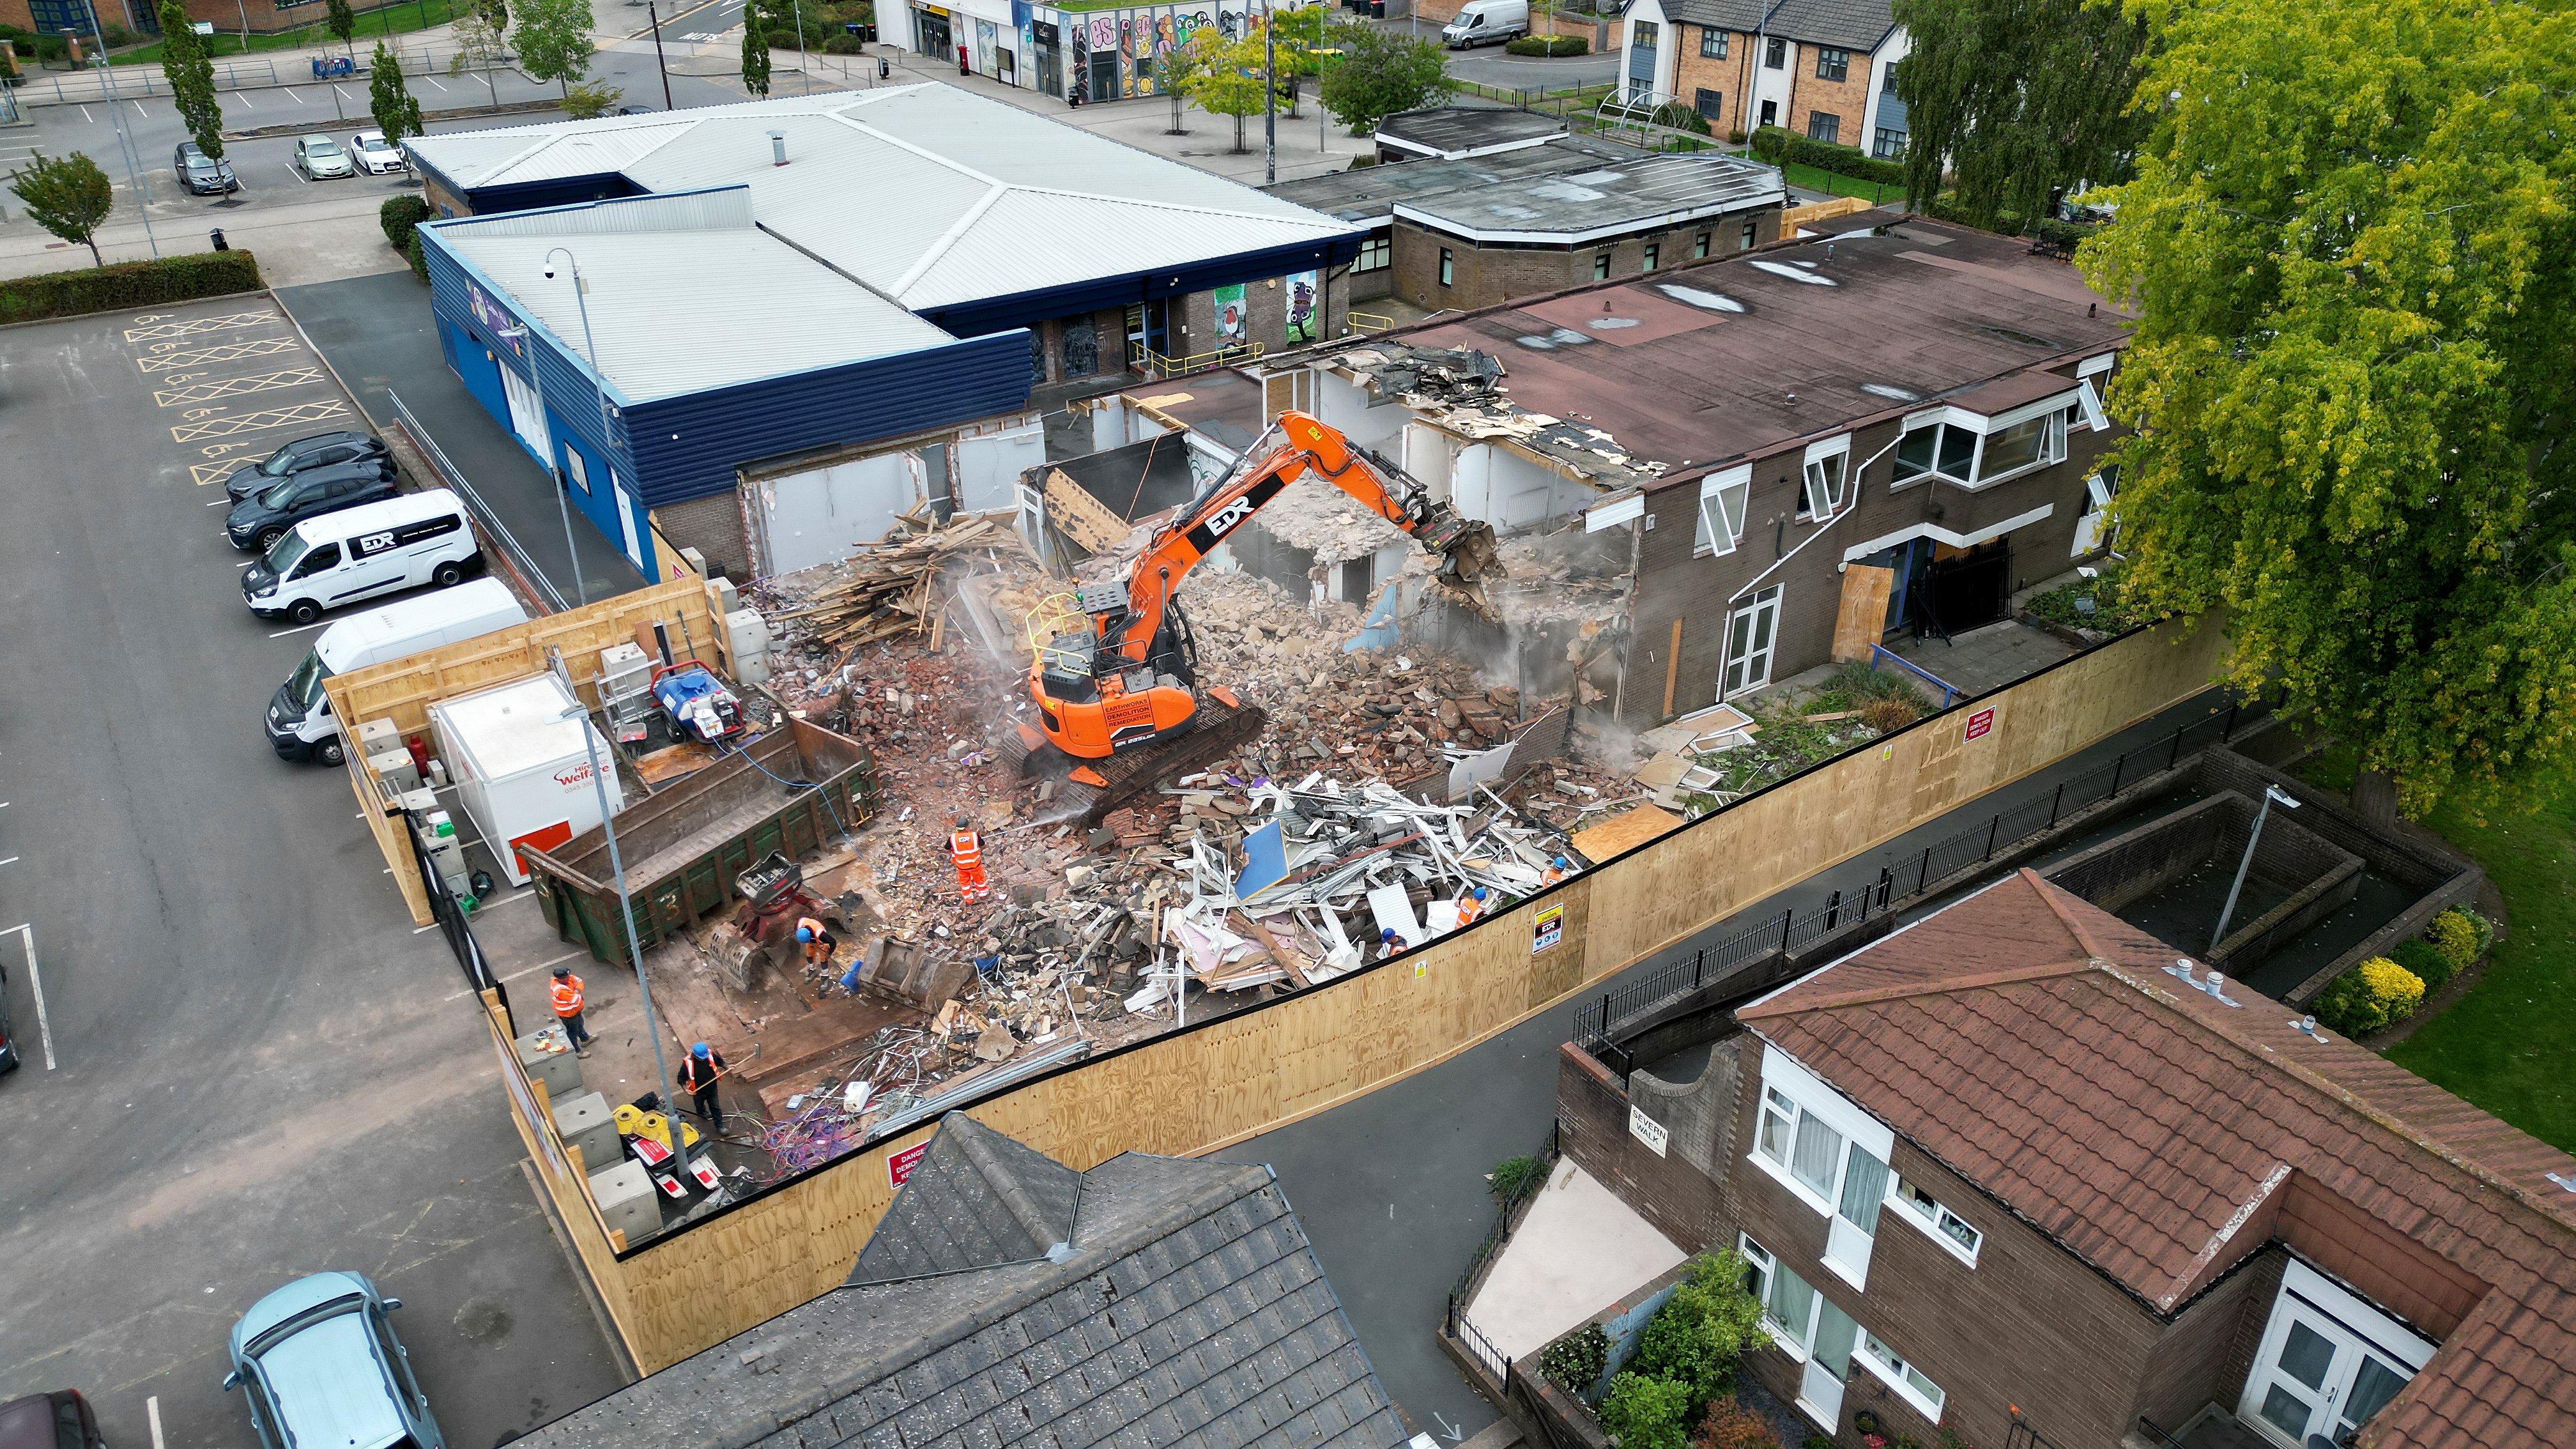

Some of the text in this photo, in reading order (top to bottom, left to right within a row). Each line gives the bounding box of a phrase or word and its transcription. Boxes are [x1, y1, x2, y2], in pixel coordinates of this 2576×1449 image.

[1204, 496, 1255, 537] EDR
[360, 532, 396, 552] EDR
[1105, 699, 1147, 712] EARTHWORKS
[1107, 706, 1149, 720] DEMOLITION
[1109, 714, 1151, 727] REMEDIATION
[1974, 712, 1989, 723] DANGER
[561, 765, 609, 786] Welfae
[1542, 921, 1556, 933] EDR
[1632, 1109, 1666, 1140] SEVERN
[1636, 1122, 1659, 1145] WALK
[901, 1148, 926, 1163] DANGE
